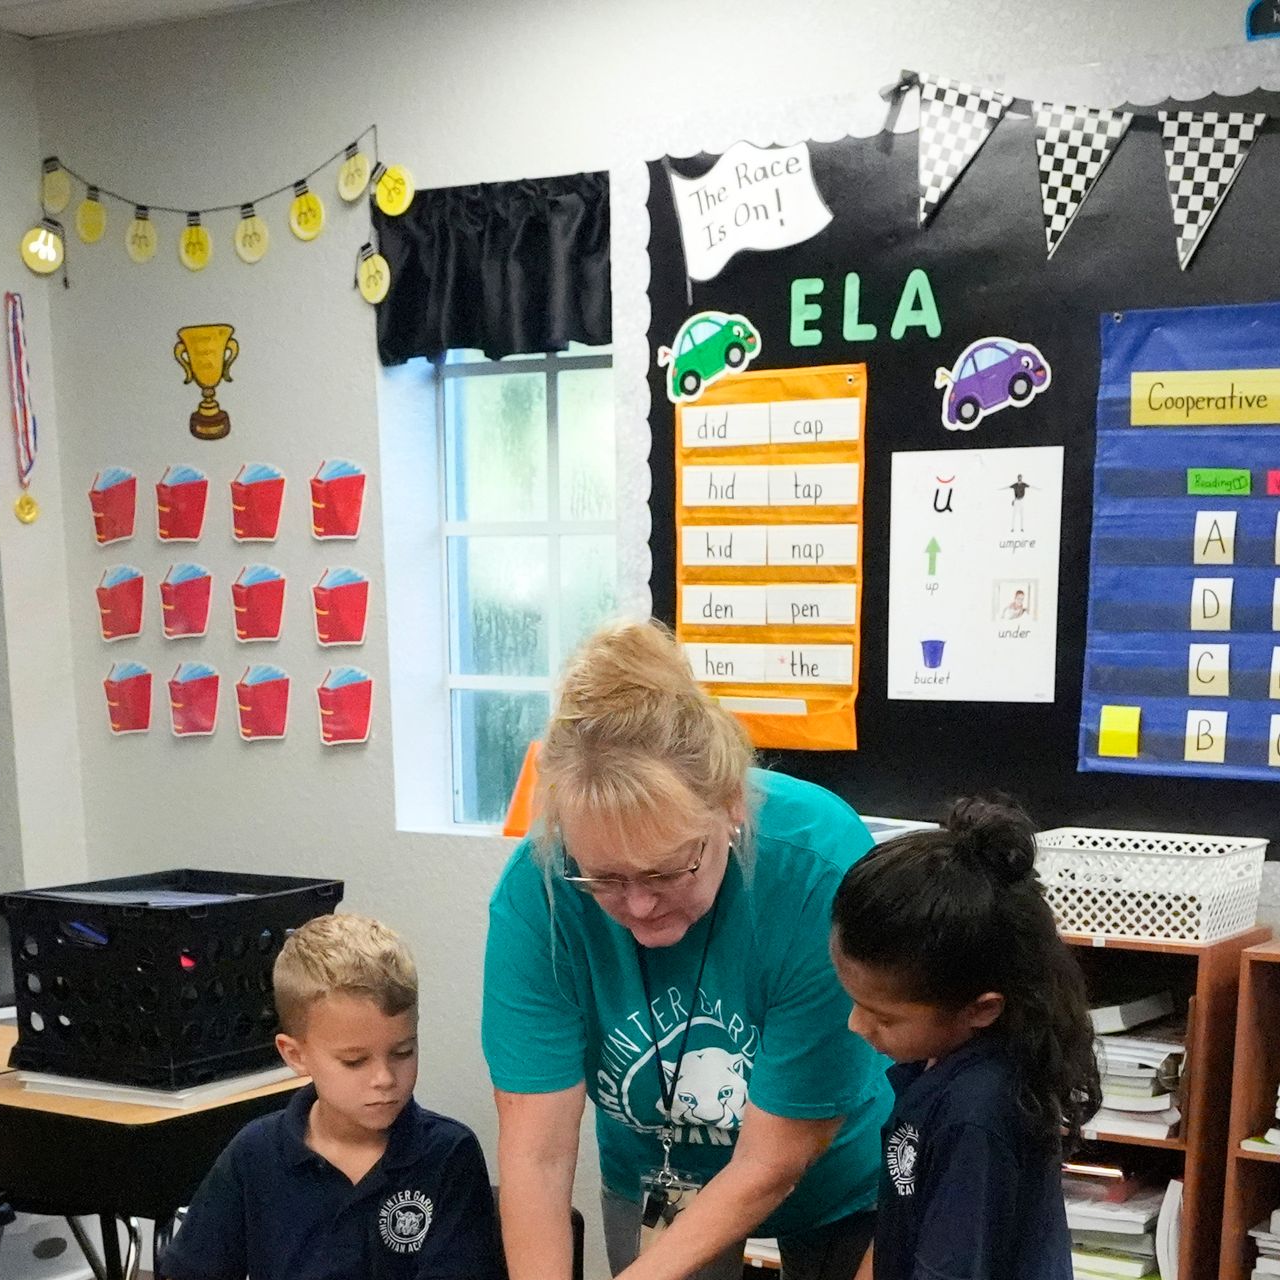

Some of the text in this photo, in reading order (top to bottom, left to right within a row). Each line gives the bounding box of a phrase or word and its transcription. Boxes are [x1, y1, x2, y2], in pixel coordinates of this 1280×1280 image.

[688, 156, 803, 217] The Race
[704, 187, 786, 252] Is On!
[790, 268, 943, 347] ELA
[1147, 382, 1268, 417] Cooperative
[697, 411, 824, 440] did cap
[708, 472, 824, 503] hid tap
[706, 530, 825, 563] kid nap
[998, 537, 1036, 554] umpire
[1202, 519, 1227, 557] A
[925, 582, 940, 596] up
[1203, 588, 1220, 619] D
[702, 593, 821, 626] den pen
[998, 627, 1031, 640] under
[705, 649, 820, 678] hen the
[914, 672, 951, 686] bucket
[1196, 651, 1216, 685] C
[1196, 719, 1215, 751] B
[379, 1189, 411, 1218] WINTER
